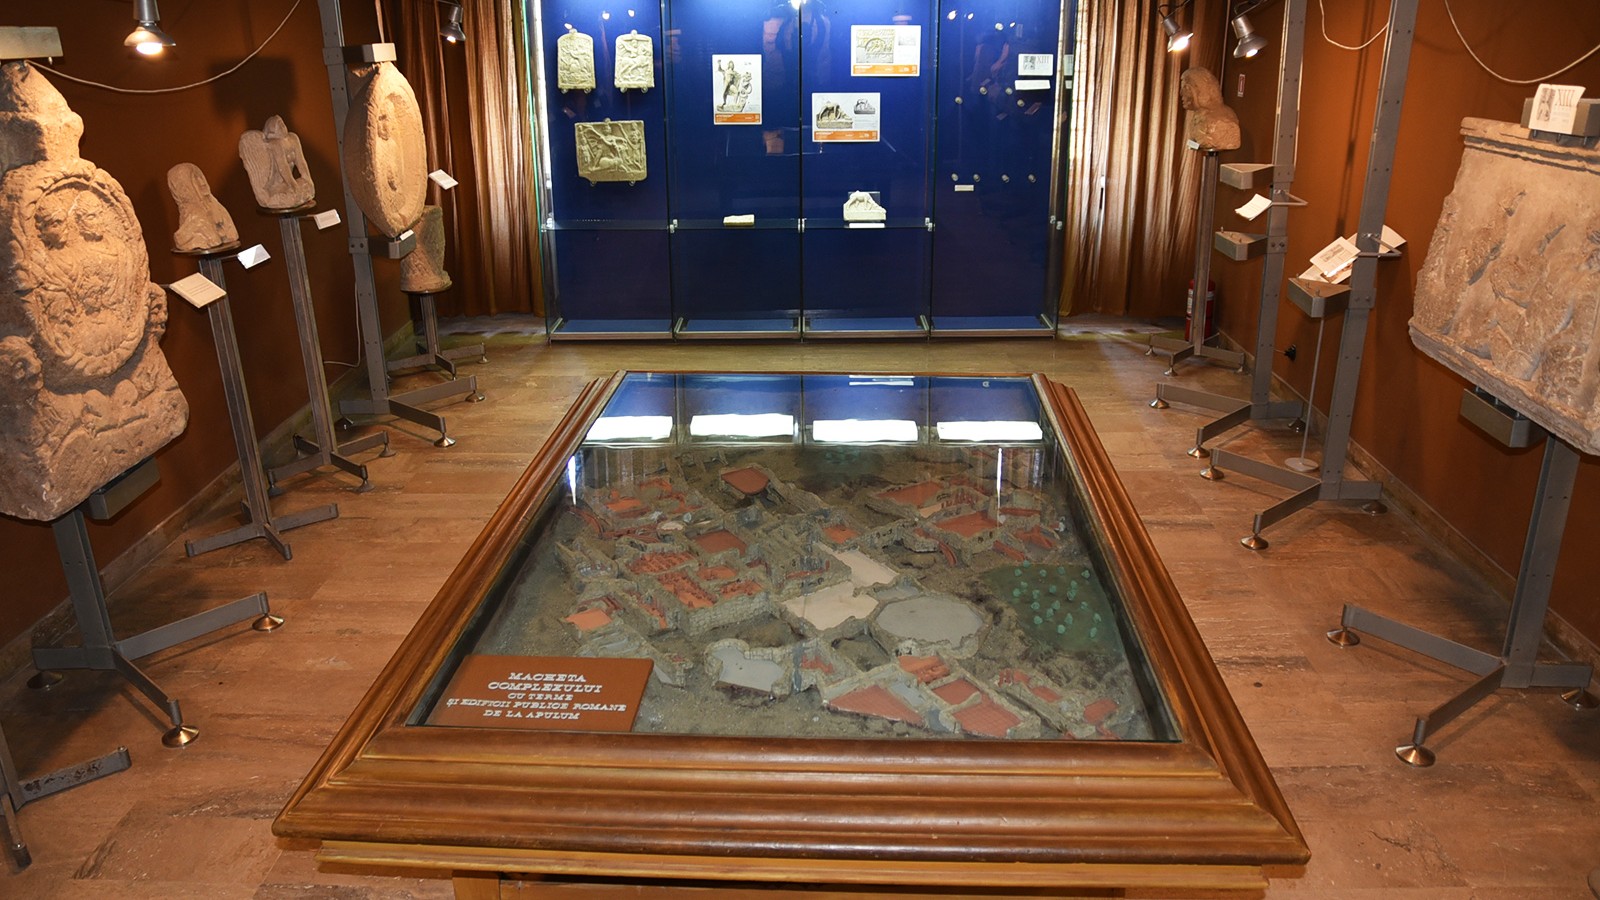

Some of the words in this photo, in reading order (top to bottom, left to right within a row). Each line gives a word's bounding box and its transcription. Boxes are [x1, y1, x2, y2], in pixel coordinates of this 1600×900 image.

[508, 672, 586, 682] MACHETA
[488, 682, 602, 693] COMPLEXULUI
[507, 692, 525, 700] CU
[528, 693, 574, 701] TERME
[460, 699, 511, 707] EDIFICII
[513, 701, 569, 710] PUBLICE
[572, 703, 627, 712] ROMANE
[483, 709, 502, 717] DE
[505, 710, 523, 718] LA
[526, 711, 580, 720] APULUM
